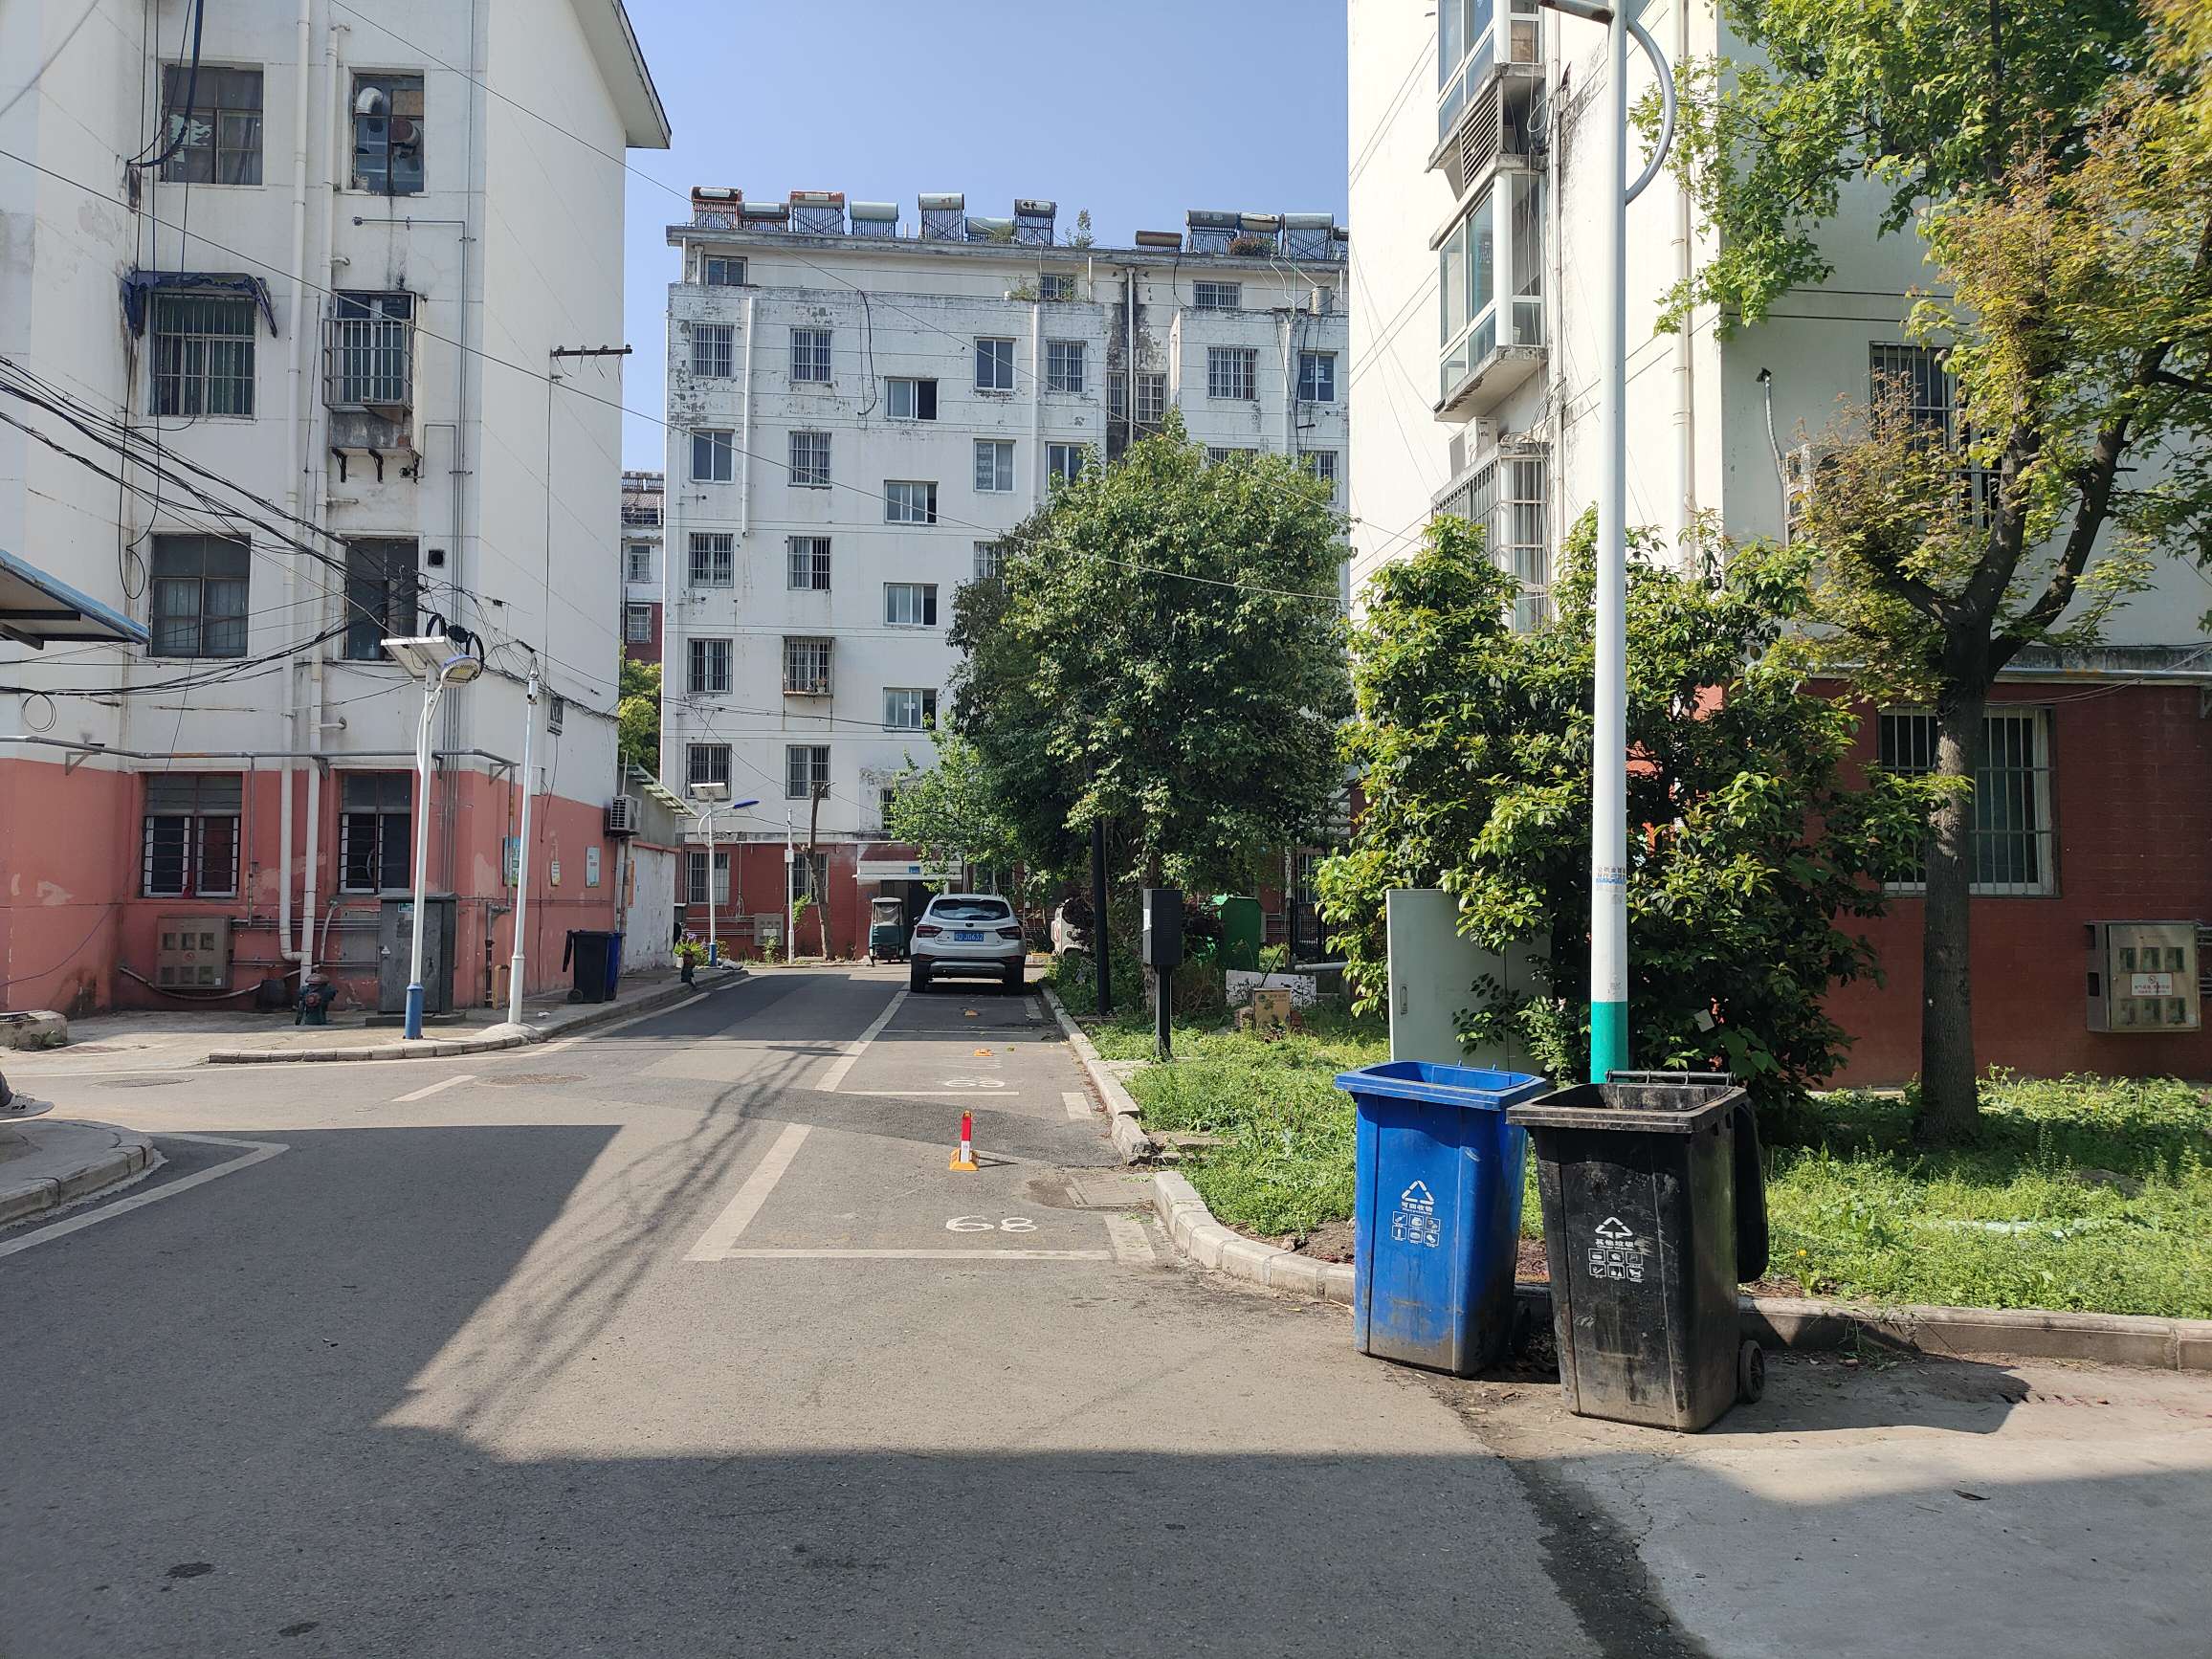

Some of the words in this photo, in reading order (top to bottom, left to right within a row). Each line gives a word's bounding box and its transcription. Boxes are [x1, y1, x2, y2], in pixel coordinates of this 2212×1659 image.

[1401, 1201, 1433, 1213] 可回收物
[945, 1215, 1038, 1233] 68
[1594, 1238, 1634, 1248] 其他垃圾
